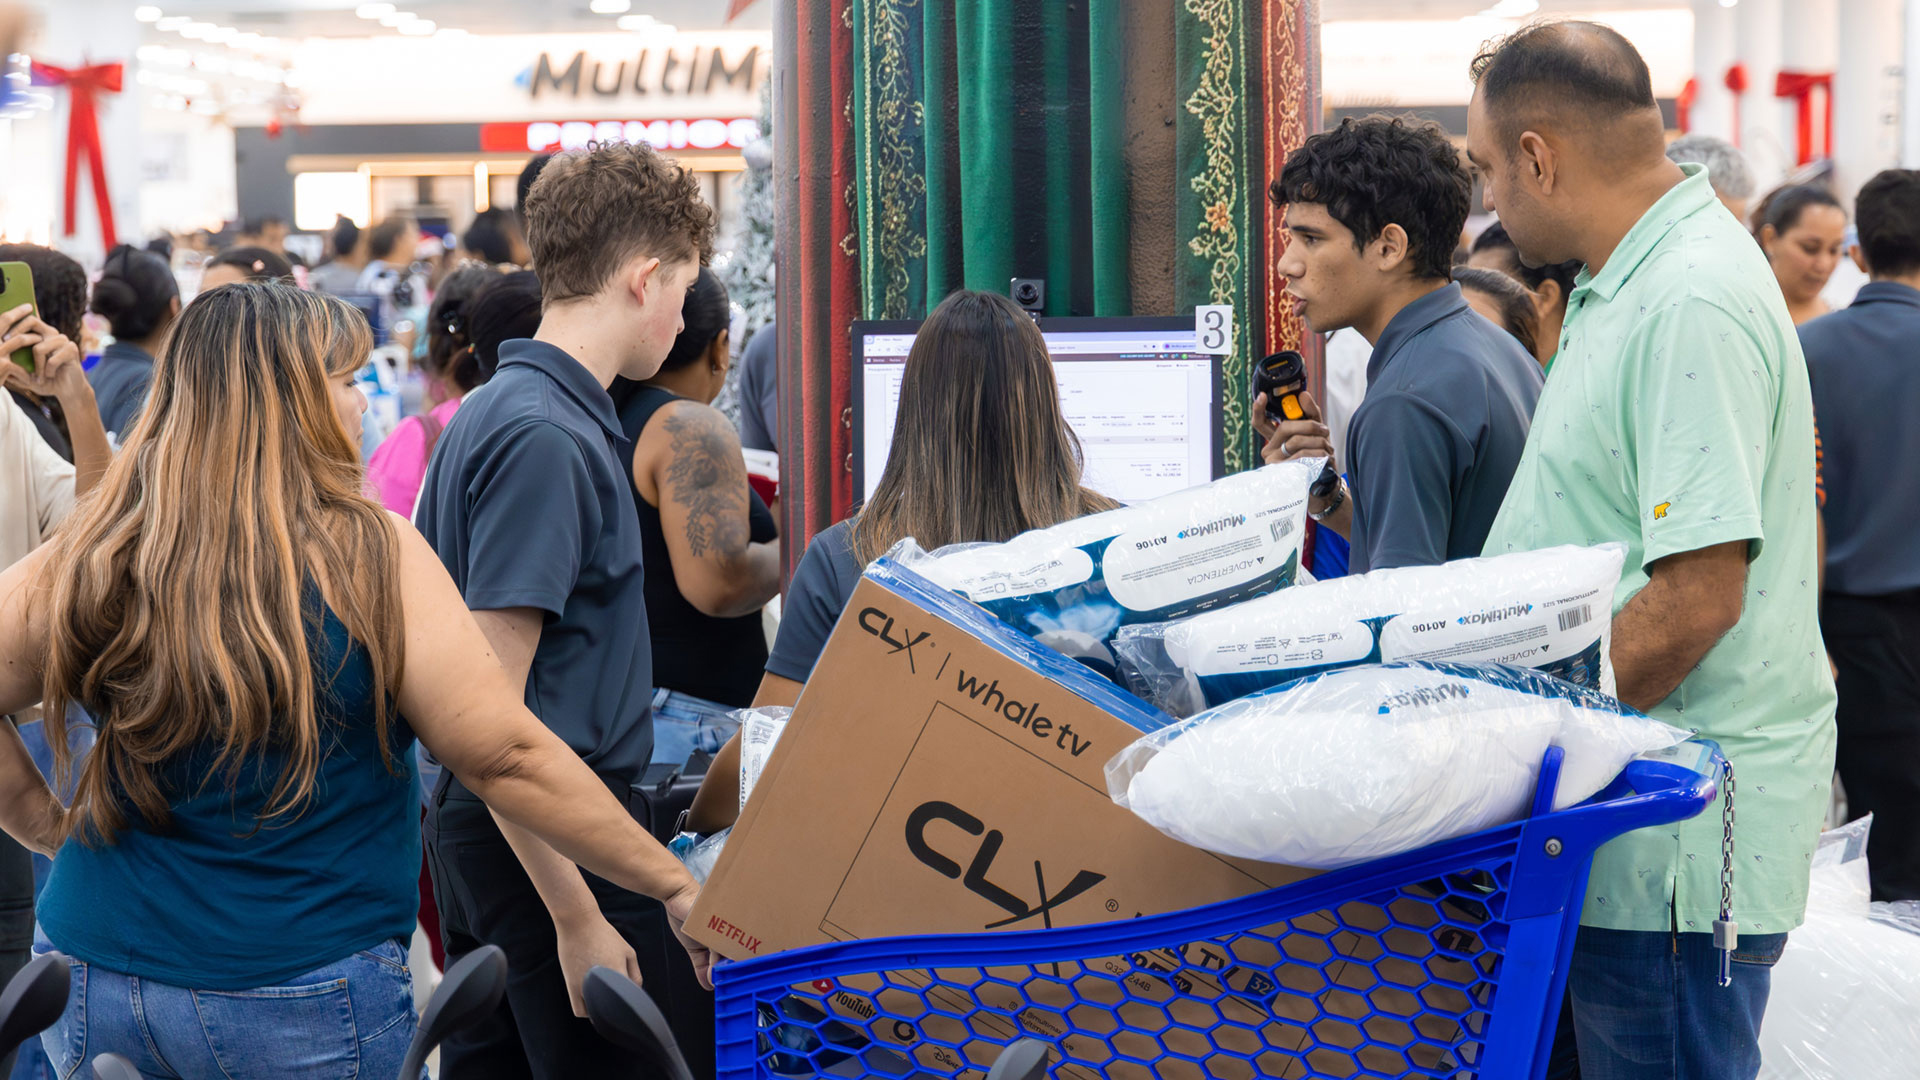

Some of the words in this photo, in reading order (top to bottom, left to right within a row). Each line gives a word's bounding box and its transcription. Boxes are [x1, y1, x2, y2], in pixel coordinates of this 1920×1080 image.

[1202, 310, 1225, 349] 3
[1183, 514, 1244, 539] MultiMax
[1136, 534, 1168, 551] A0106
[1187, 558, 1254, 585] ADVERTENCIA
[1542, 601, 1556, 609] SIZE
[1557, 588, 1600, 606] INSTITUCIONAL
[1412, 619, 1446, 634] A0106
[1463, 603, 1531, 626] MultiMax
[858, 606, 931, 675] CLX
[956, 669, 1053, 739] whale
[1059, 723, 1092, 758] tv
[905, 800, 1107, 984] CLX
[707, 914, 762, 954] NETFLIX
[1104, 961, 1152, 992] Q32244B
